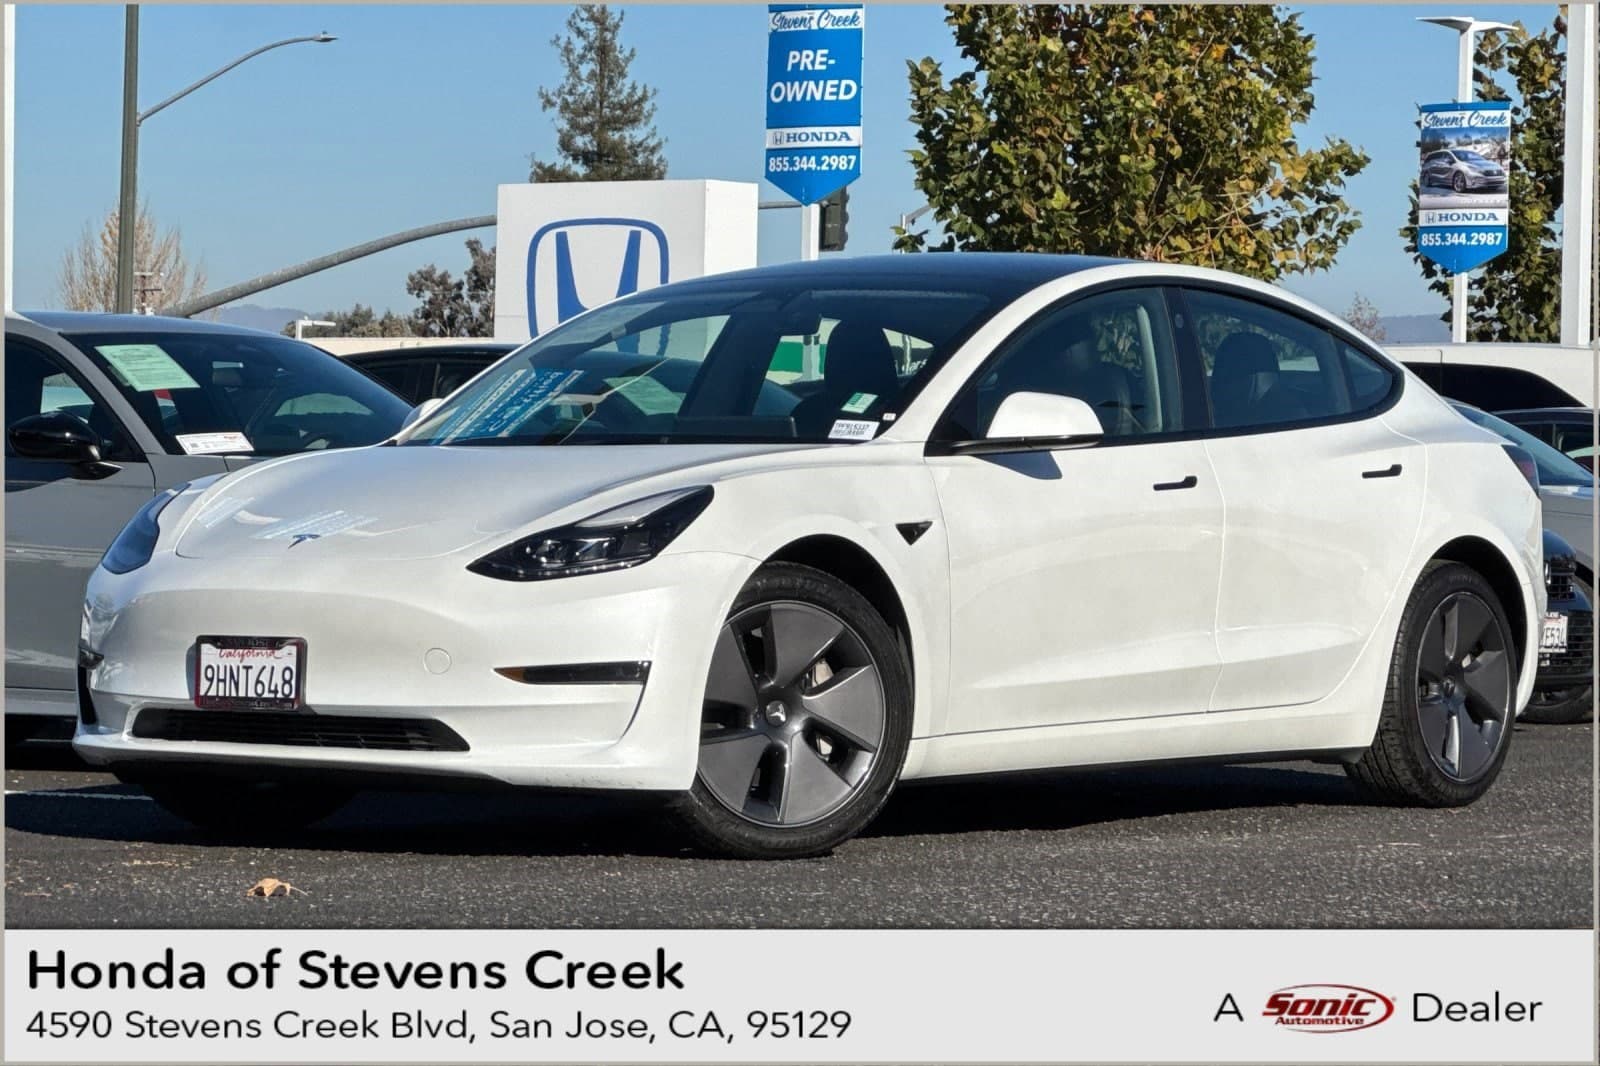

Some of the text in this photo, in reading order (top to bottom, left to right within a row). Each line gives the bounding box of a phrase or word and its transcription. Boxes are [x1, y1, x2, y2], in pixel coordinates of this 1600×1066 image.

[772, 9, 861, 32] Stevens Creek
[787, 49, 835, 71] PRE-
[770, 79, 858, 103] OWNED
[1424, 110, 1507, 128] Stevens Creek
[786, 131, 853, 143] HONDA
[768, 155, 857, 172] 855.344.2987
[1438, 212, 1499, 222] HONDA
[1421, 232, 1503, 246] 855.344.2987
[204, 664, 294, 698] 9HNT648
